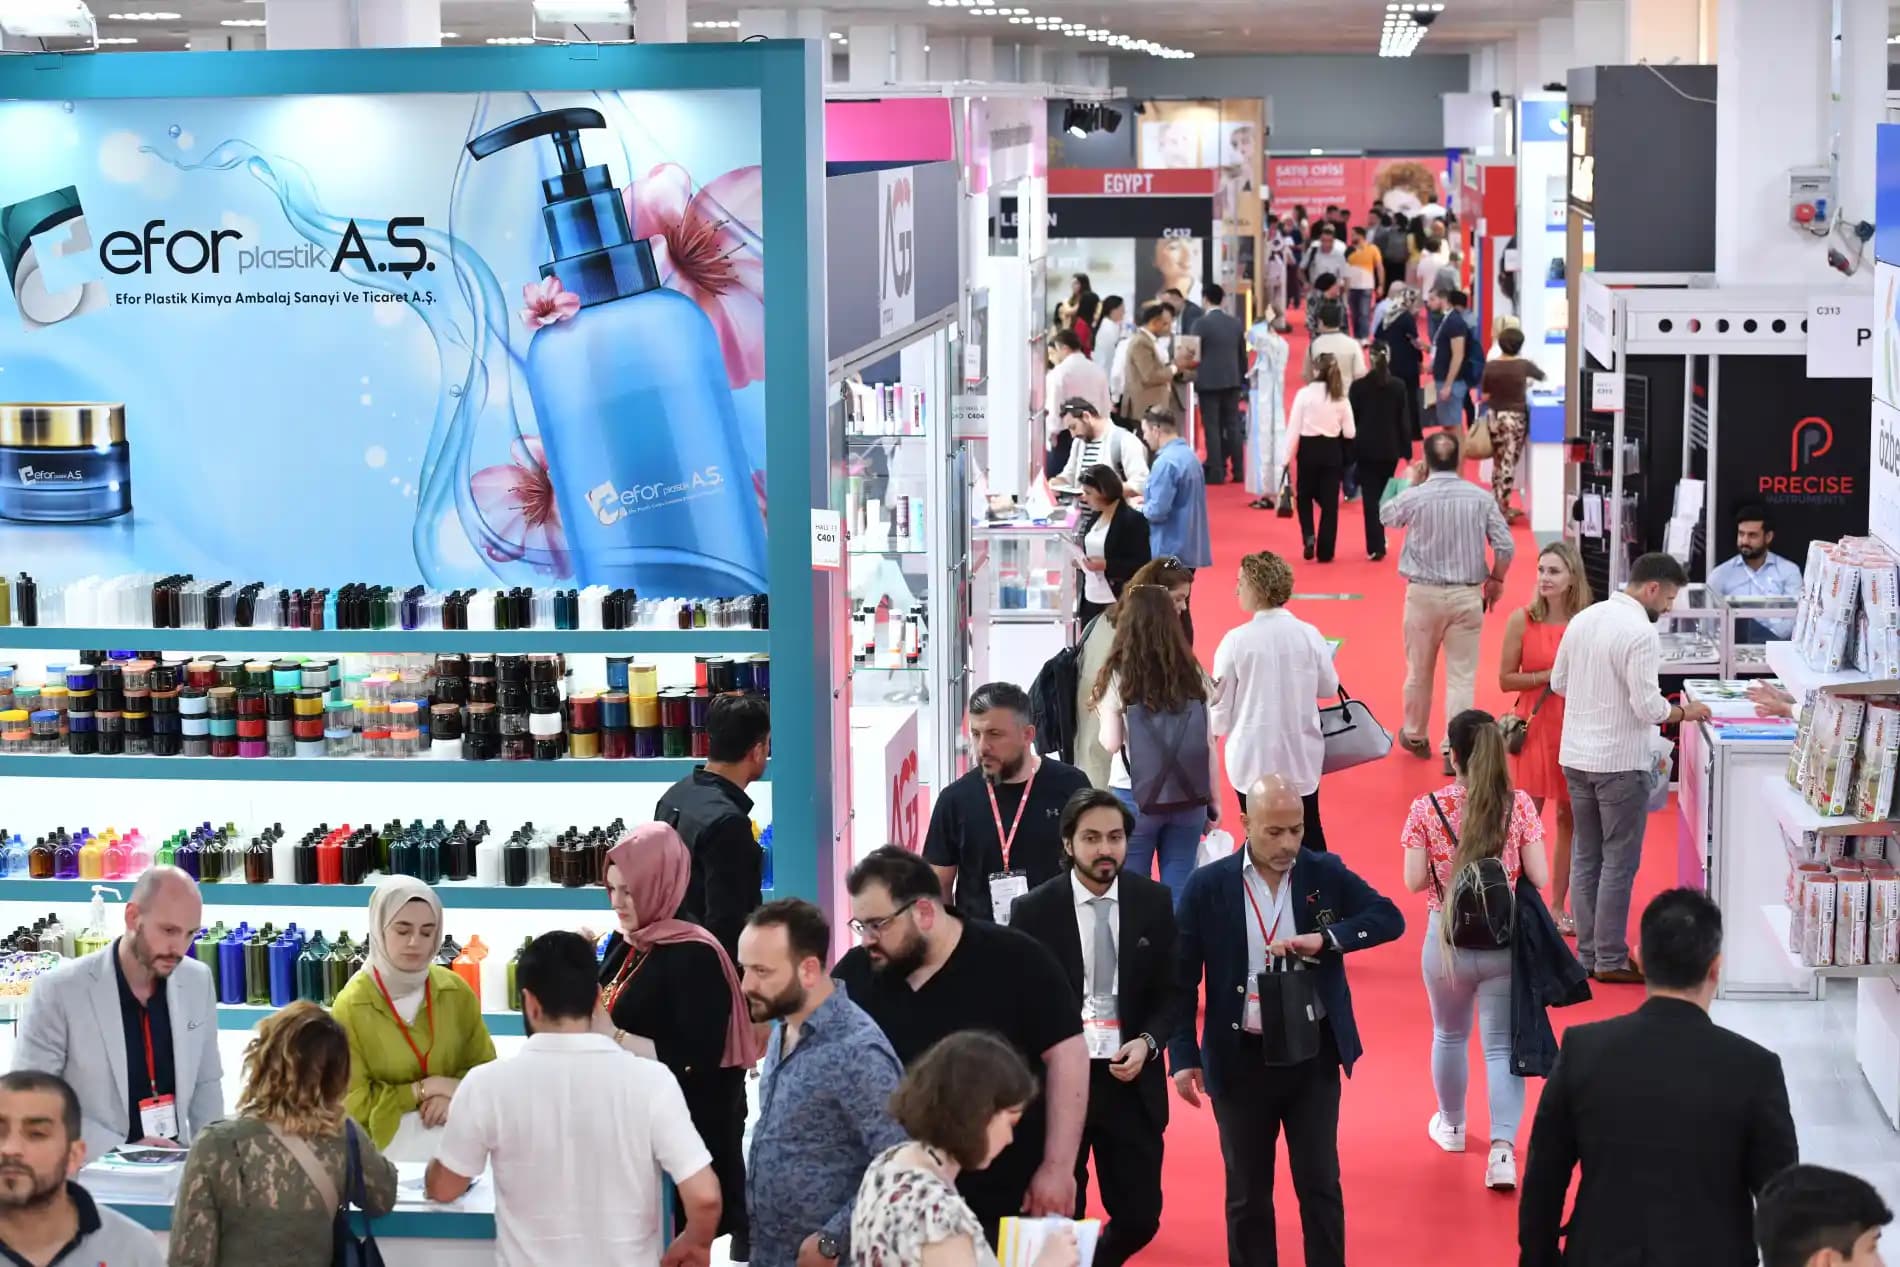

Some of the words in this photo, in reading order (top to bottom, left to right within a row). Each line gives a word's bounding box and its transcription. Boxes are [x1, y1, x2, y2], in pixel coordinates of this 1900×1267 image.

[1103, 173, 1154, 194] EGYPT
[100, 219, 244, 275] efor
[238, 243, 327, 275] plastik
[329, 216, 436, 281] A.Ş.
[115, 293, 142, 305] Efor
[144, 292, 188, 305] Plastik
[191, 292, 232, 308] Kimya
[235, 291, 291, 307] Ambalaj
[294, 291, 340, 307] Sanayi
[342, 291, 360, 304] Ve
[362, 291, 409, 304] Ticaret
[412, 291, 437, 307] A.Ş.
[1816, 306, 1841, 316] C313
[620, 481, 664, 506] efor
[1759, 476, 1854, 494] PRECISE
[817, 533, 835, 543] C401
